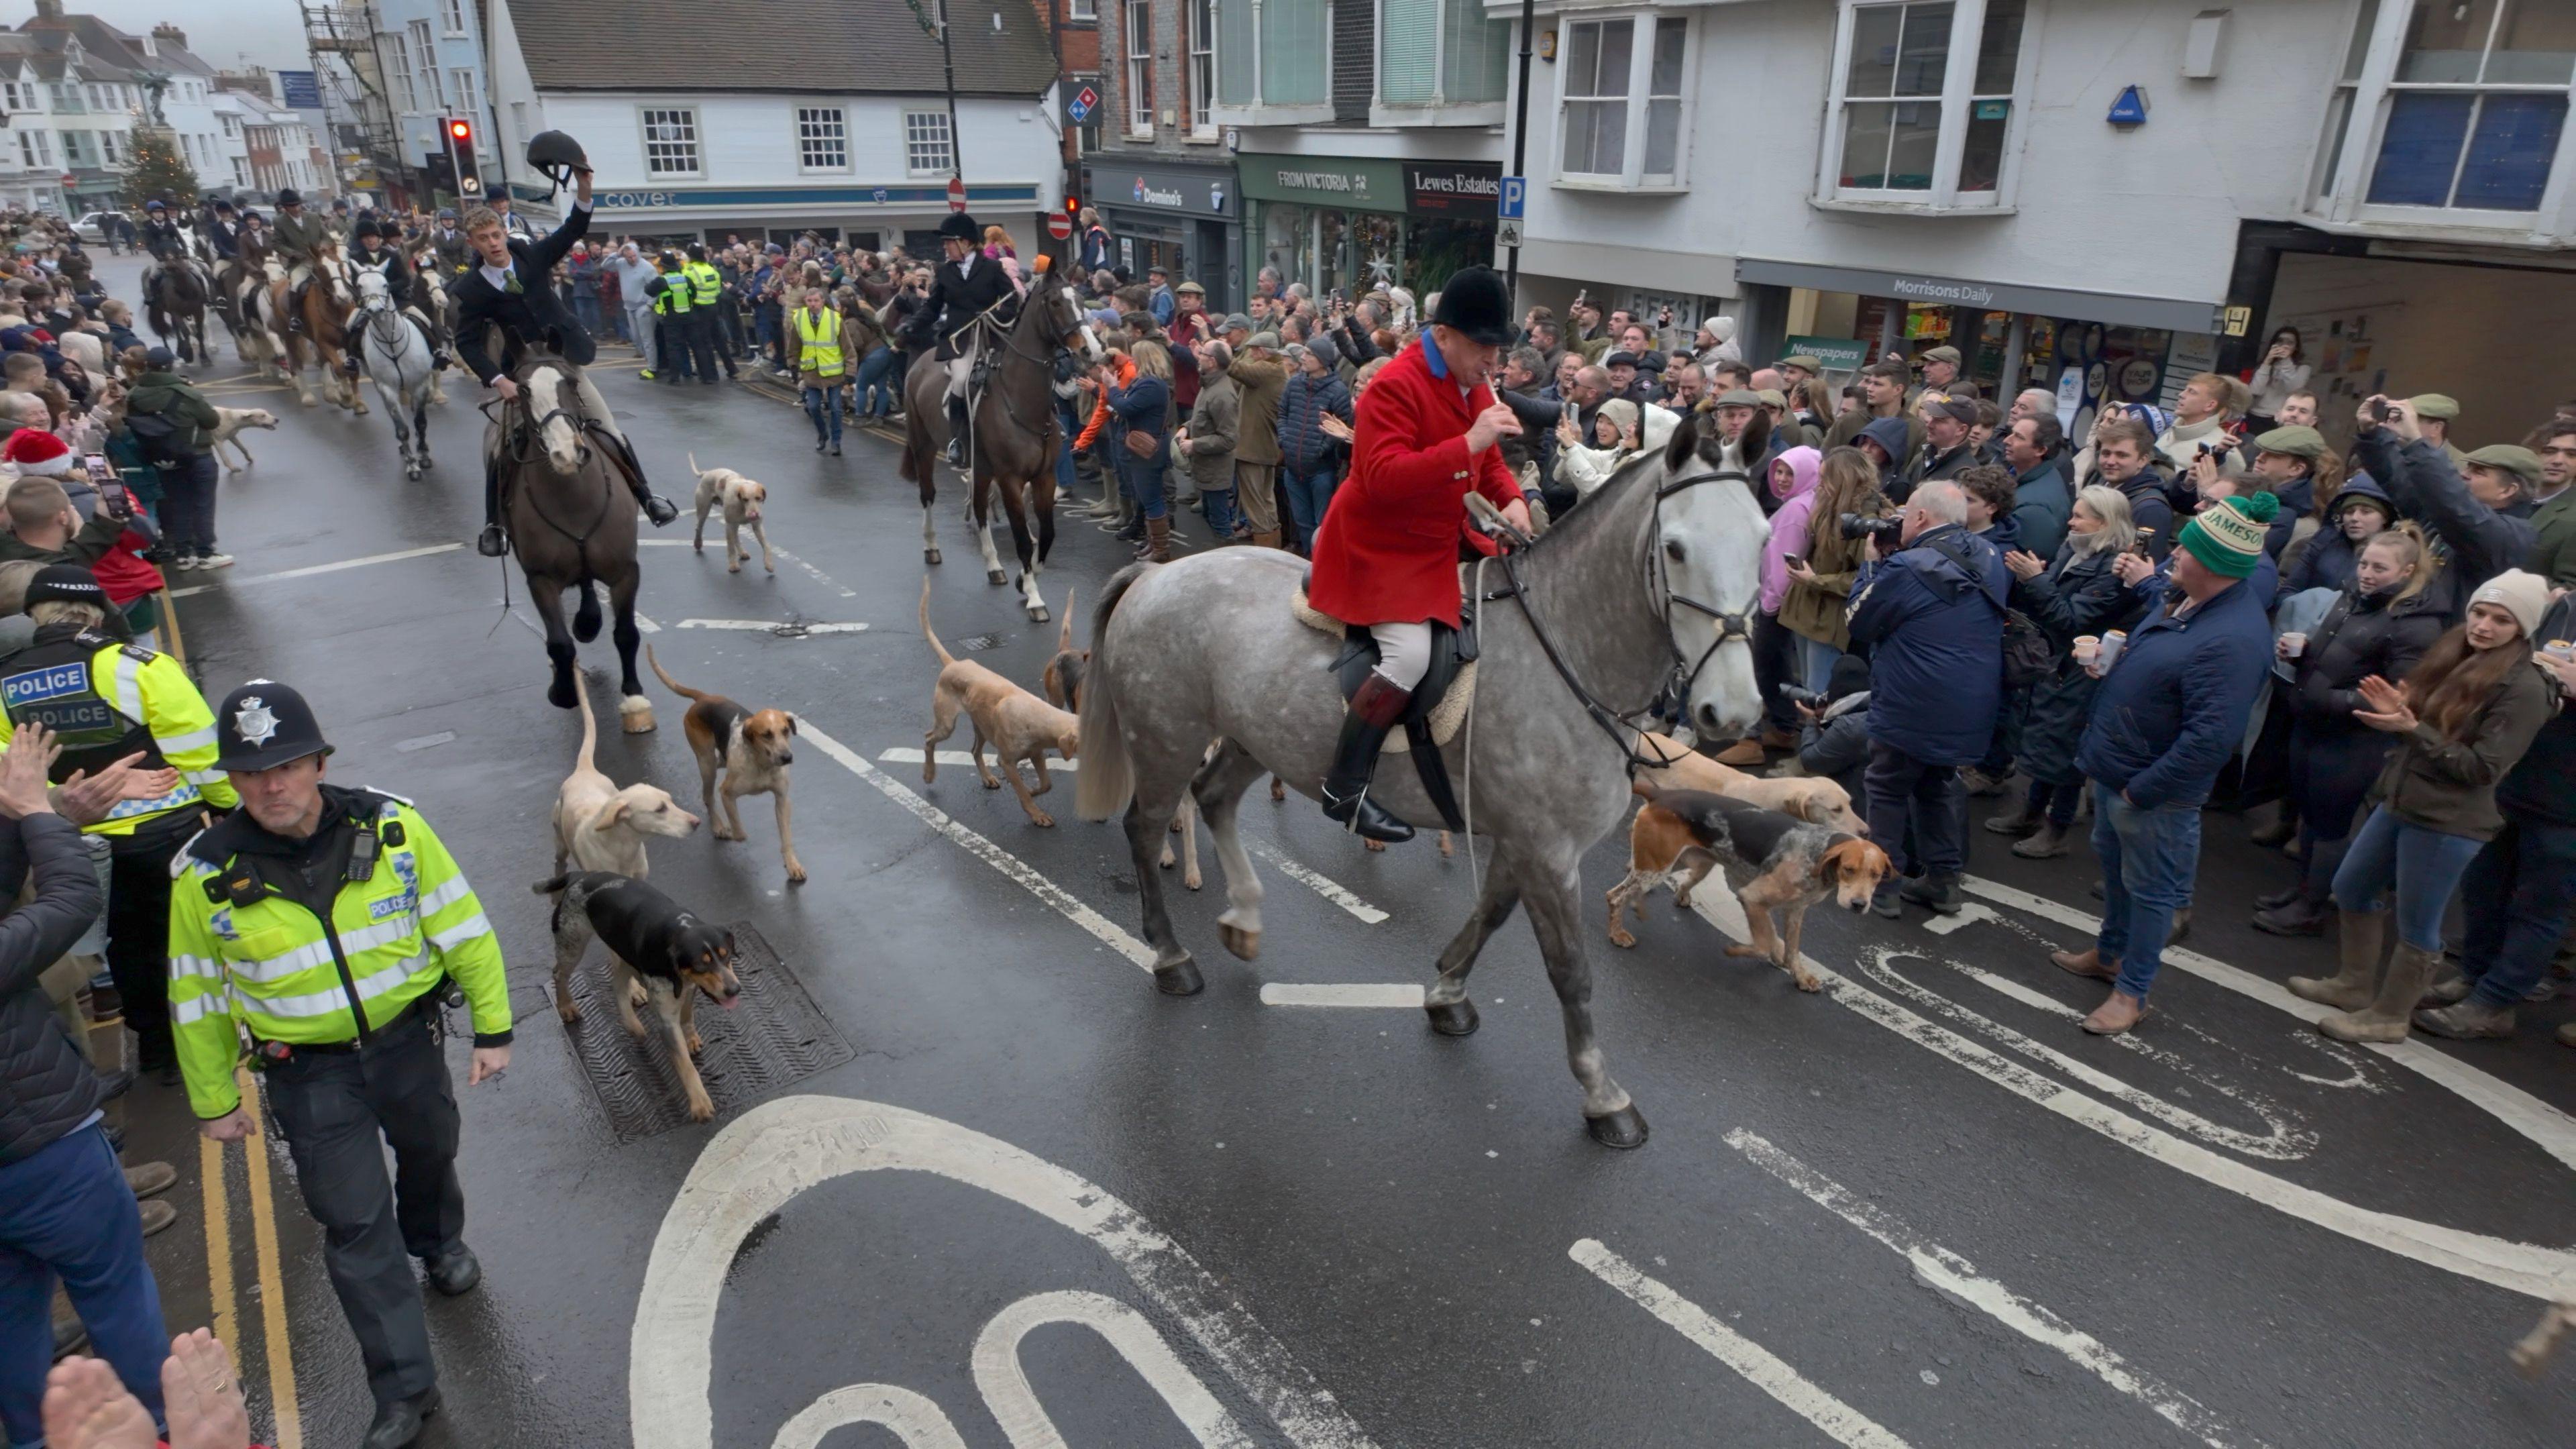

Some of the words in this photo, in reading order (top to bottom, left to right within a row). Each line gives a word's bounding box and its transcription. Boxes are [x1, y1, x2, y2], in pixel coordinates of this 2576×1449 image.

[1277, 171, 1305, 188] FROM
[1304, 173, 1350, 192] VICTORIA
[1413, 172, 1454, 193] Lewes
[1454, 174, 1500, 195] Estates
[604, 192, 680, 208] covet
[1144, 187, 1182, 206] Domino's
[1505, 181, 1522, 215] P
[1894, 278, 1960, 299] Morrisons
[1961, 286, 1993, 305] Daily
[1790, 343, 1859, 362] Newspapers
[2204, 511, 2263, 547] JAMESON
[7, 670, 81, 699] POLICE
[29, 706, 107, 725] POLICE
[370, 896, 408, 917] POLCE
